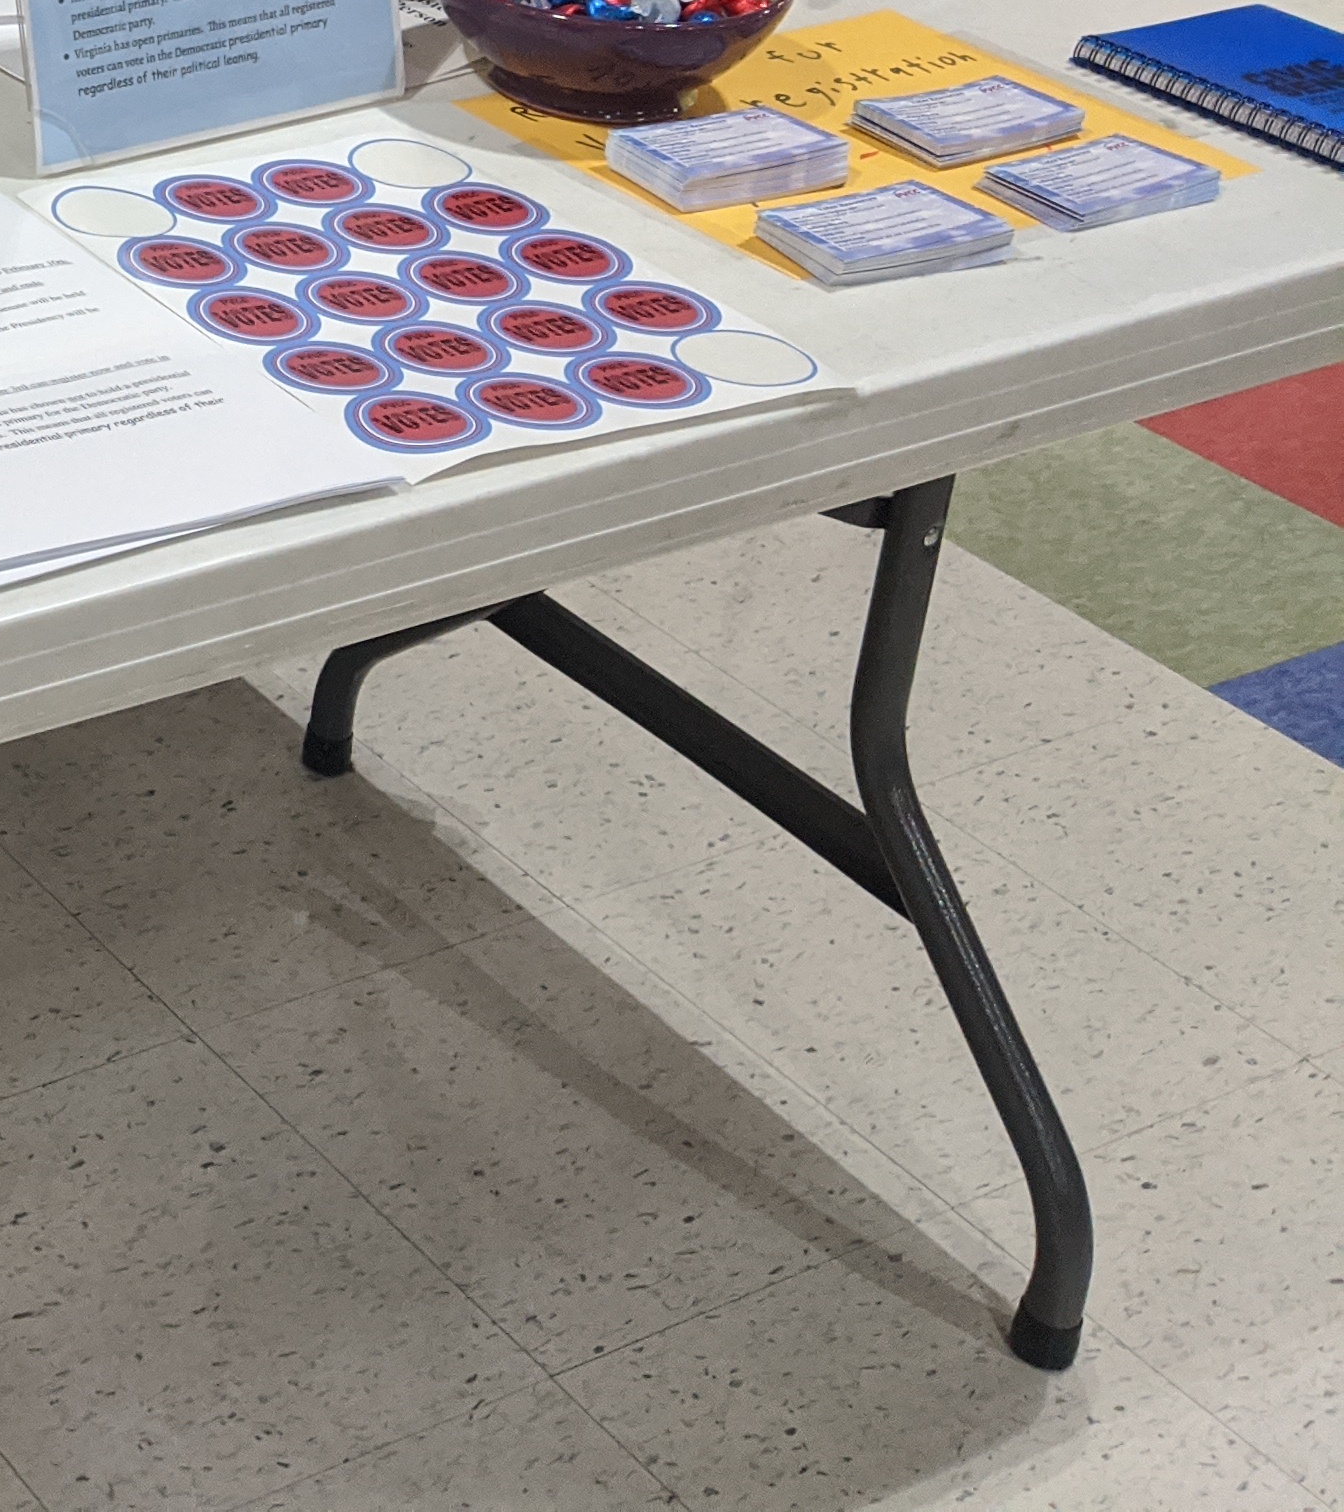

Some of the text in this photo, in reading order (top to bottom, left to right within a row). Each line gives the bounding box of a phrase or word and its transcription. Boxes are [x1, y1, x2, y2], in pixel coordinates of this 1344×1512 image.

[279, 172, 341, 194] VOTES
[179, 187, 251, 210] VOTES
[445, 195, 516, 222] VOTES
[349, 216, 421, 239] VOTES
[244, 237, 321, 260] VOTES
[524, 244, 604, 270] VOTES
[143, 250, 219, 273] VOTES
[424, 265, 499, 290] VOTES
[324, 285, 400, 310] VOTES
[613, 296, 690, 321] VOTES
[212, 303, 289, 329] VOTES
[502, 315, 579, 341] VOTES
[402, 337, 479, 362] VOTES
[294, 355, 369, 381] VOTES
[599, 366, 673, 393] VOTES
[485, 387, 566, 412] VOTES
[379, 405, 458, 435] VOTES
